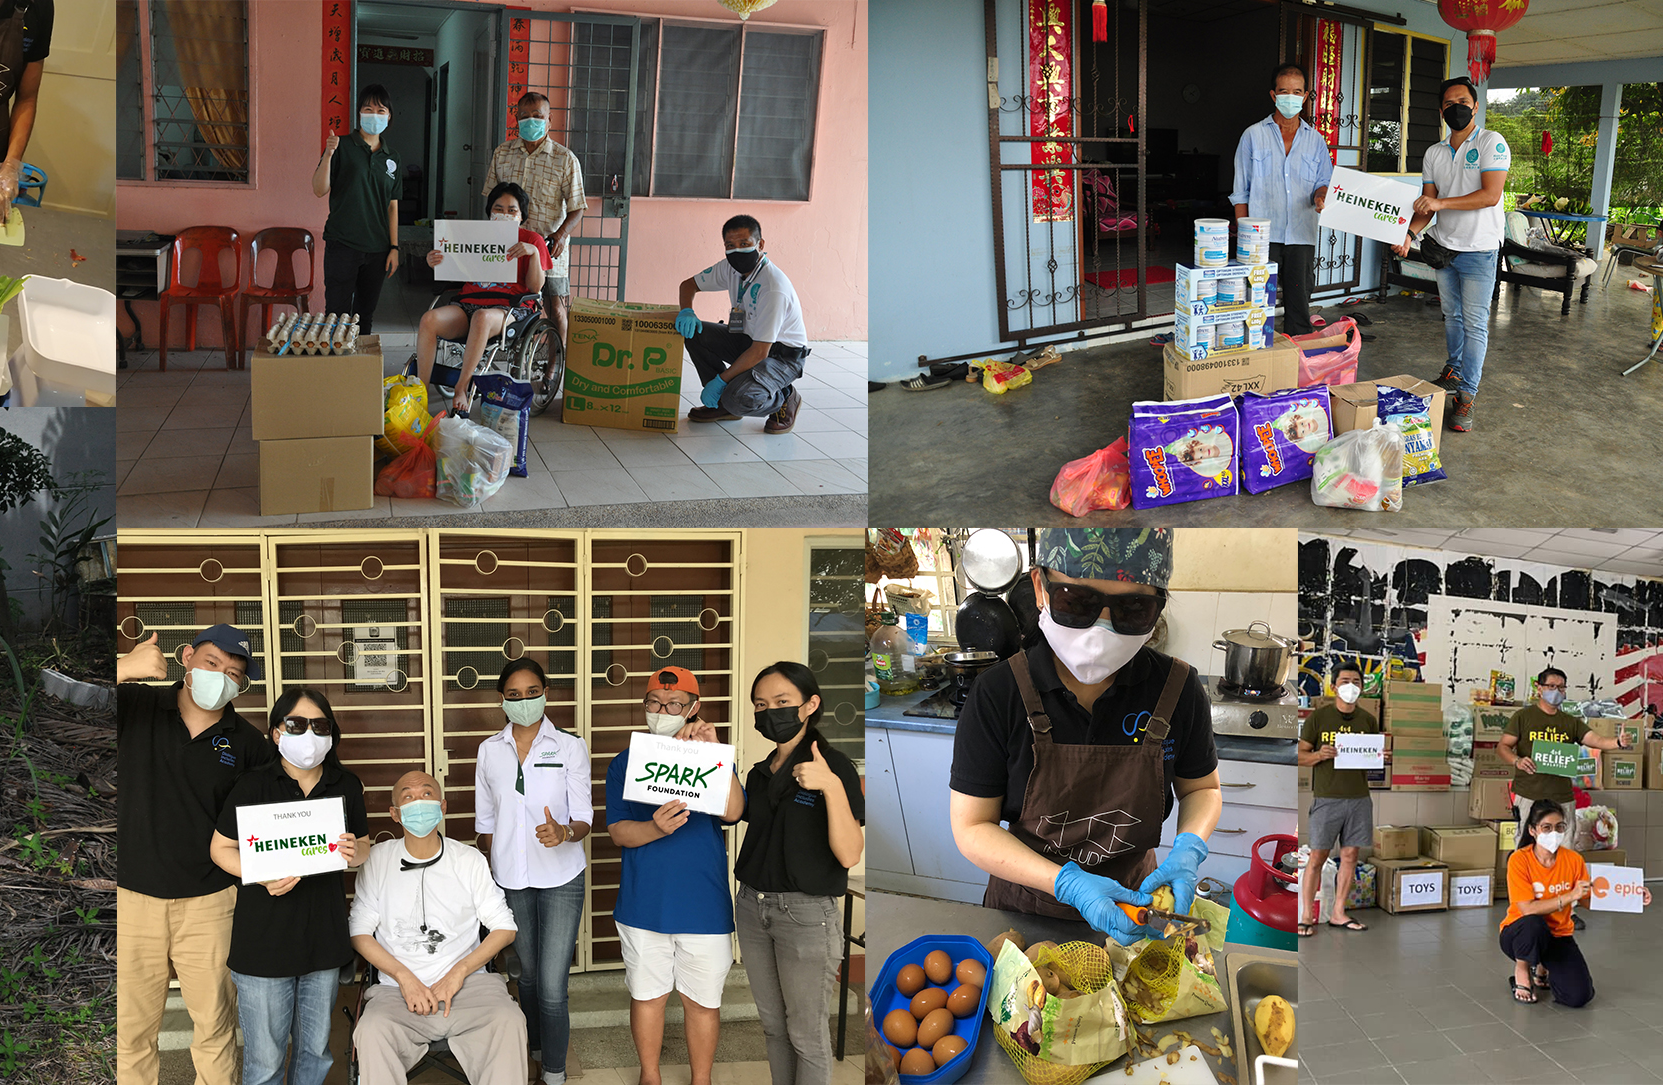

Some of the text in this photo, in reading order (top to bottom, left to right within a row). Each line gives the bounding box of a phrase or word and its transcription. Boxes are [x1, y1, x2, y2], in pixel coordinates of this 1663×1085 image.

[1337, 191, 1401, 216] HEINEKEN
[1373, 211, 1398, 224] cares
[444, 243, 506, 254] HEINEKEN
[572, 333, 598, 341] TENA
[592, 342, 667, 371] Dr. P
[571, 376, 675, 396] Dry and Comfortable
[1254, 422, 1283, 475] WHOOPEE
[1144, 445, 1172, 497] WHOOPEE
[1529, 731, 1566, 742] RELIEF
[656, 741, 699, 755] Thank you
[1535, 752, 1571, 765] RELIEF
[635, 762, 718, 788] SPARK
[647, 785, 700, 799] FOUNDATION
[273, 810, 311, 820] THANK YOU
[254, 833, 327, 853] HEINEKEN
[301, 844, 328, 856] cares
[1408, 882, 1436, 894] TOYS
[1457, 885, 1483, 895] TOYS
[1548, 880, 1570, 894] epic
[1614, 882, 1643, 897] epic
